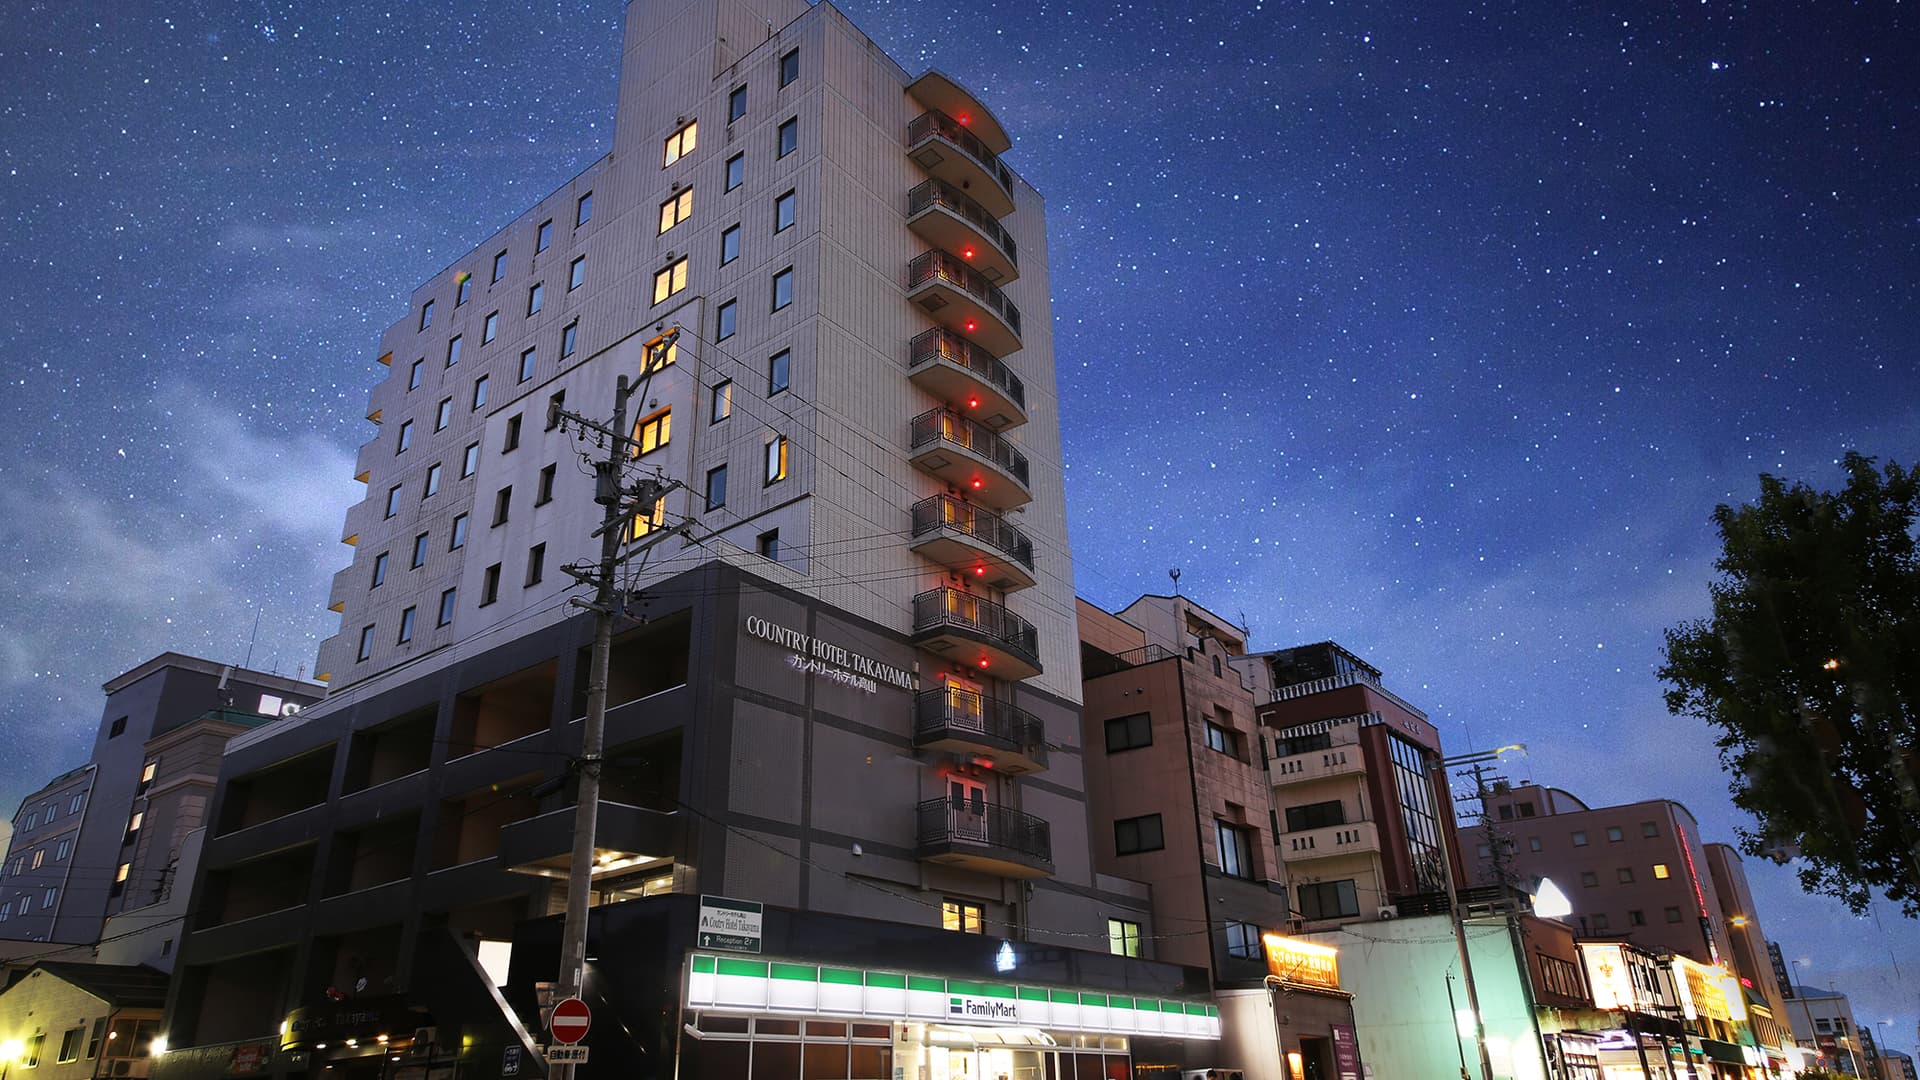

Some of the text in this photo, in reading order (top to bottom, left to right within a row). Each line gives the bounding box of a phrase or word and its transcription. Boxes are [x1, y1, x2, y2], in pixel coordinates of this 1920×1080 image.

[747, 616, 913, 690] COUNTRY HOTEL TAKAYAMA
[792, 654, 877, 694] カントリーホテル高山
[966, 999, 1016, 1018] FamilyMart
